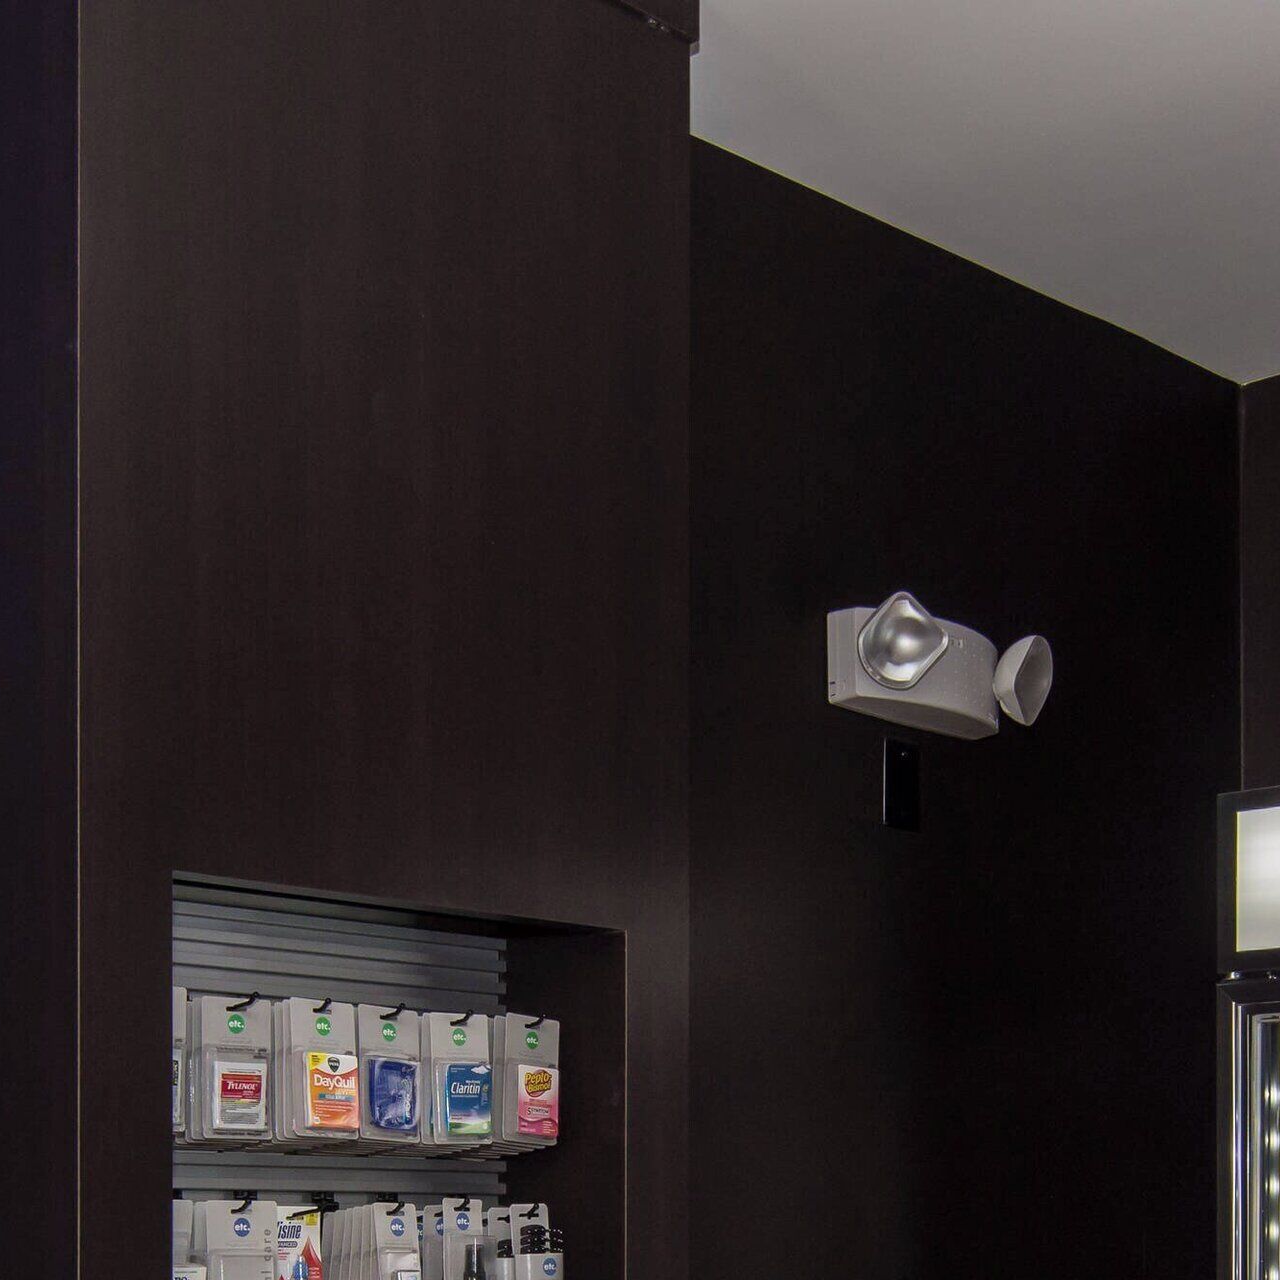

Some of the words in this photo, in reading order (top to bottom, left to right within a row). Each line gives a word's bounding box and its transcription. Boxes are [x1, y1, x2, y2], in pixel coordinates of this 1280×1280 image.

[227, 1081, 258, 1091] TYLENOL
[313, 1074, 356, 1090] DayQuil
[451, 1081, 481, 1095] Claritin
